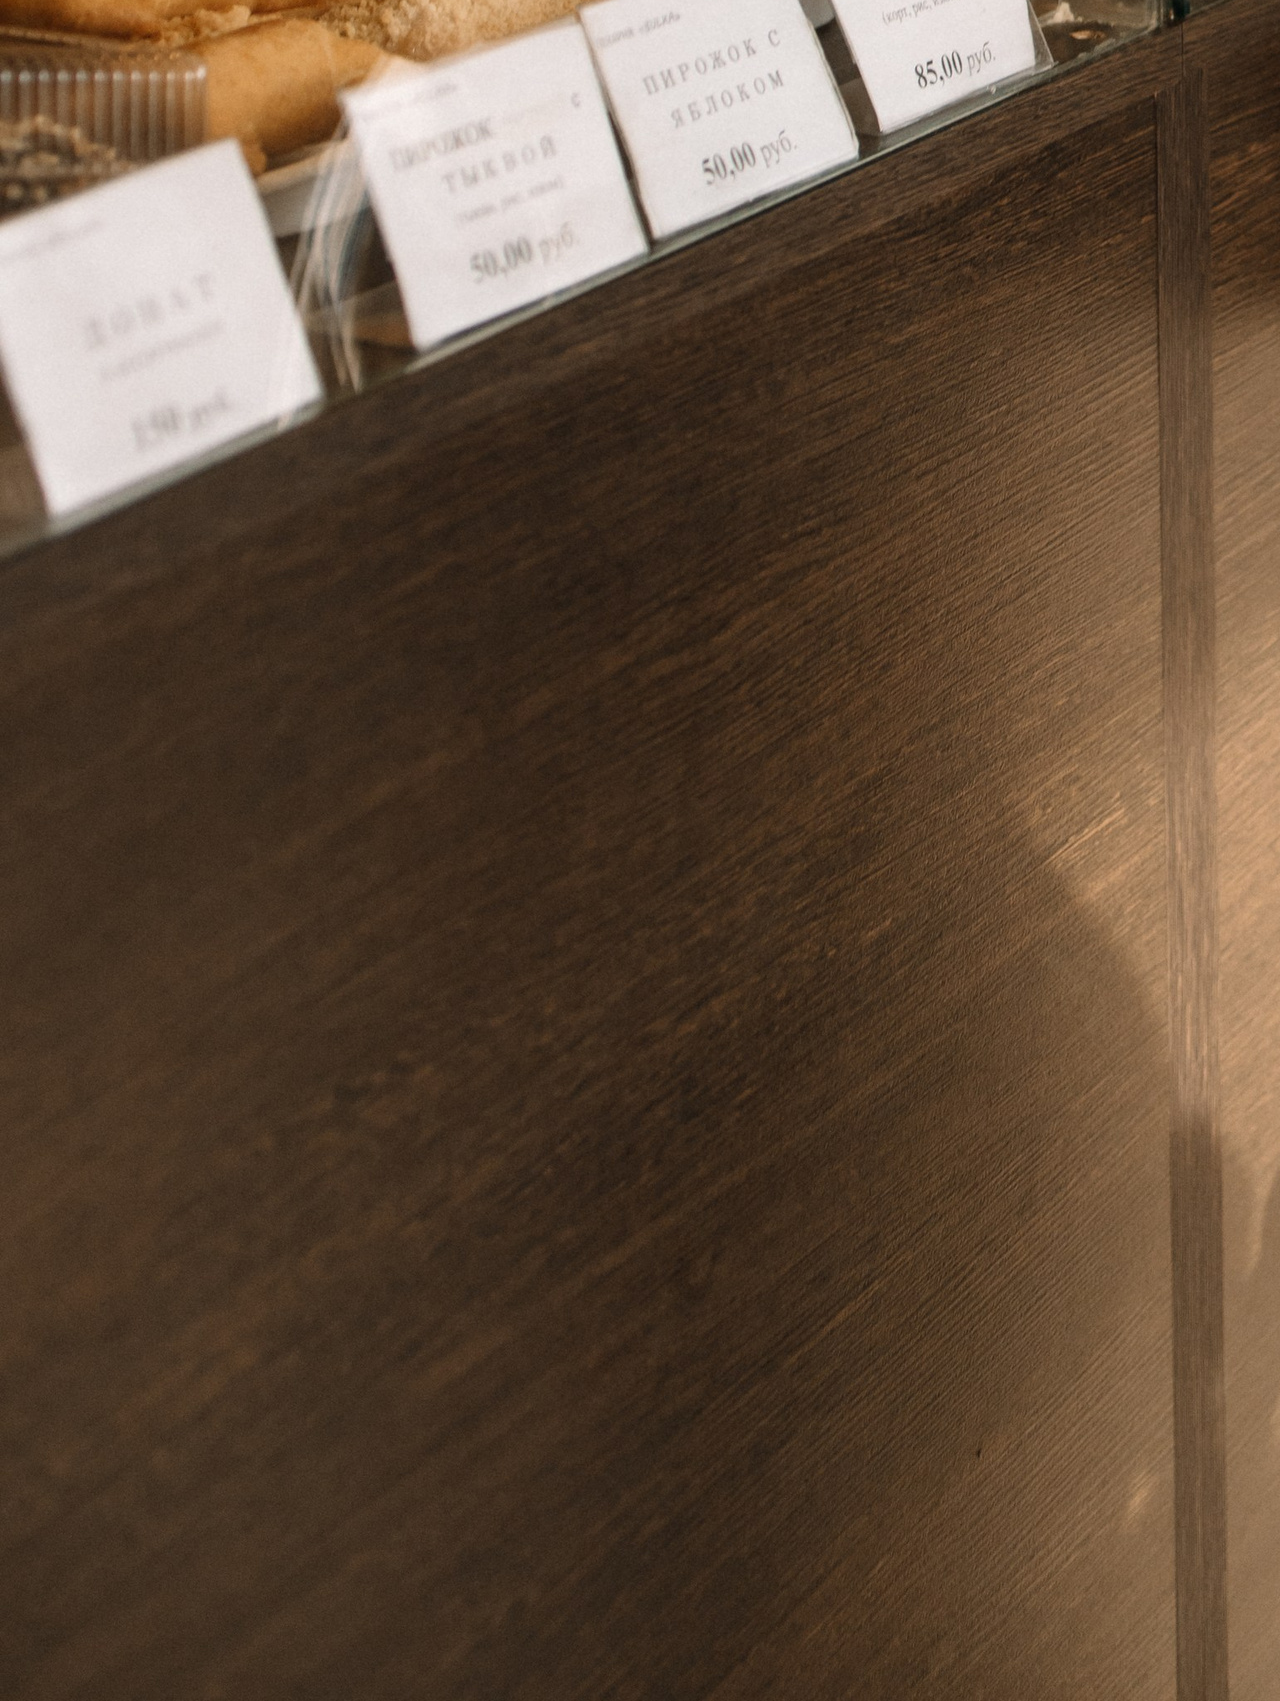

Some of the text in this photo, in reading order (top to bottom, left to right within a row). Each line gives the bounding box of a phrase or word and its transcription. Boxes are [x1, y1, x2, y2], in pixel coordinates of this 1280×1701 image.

[643, 29, 782, 96] ПИРОЖОК С
[914, 41, 996, 89] 85,00 руб.
[670, 70, 785, 129] ЯБЛОКОМ
[702, 130, 798, 186] 50,00 руб.
[470, 235, 533, 285] 50,00
